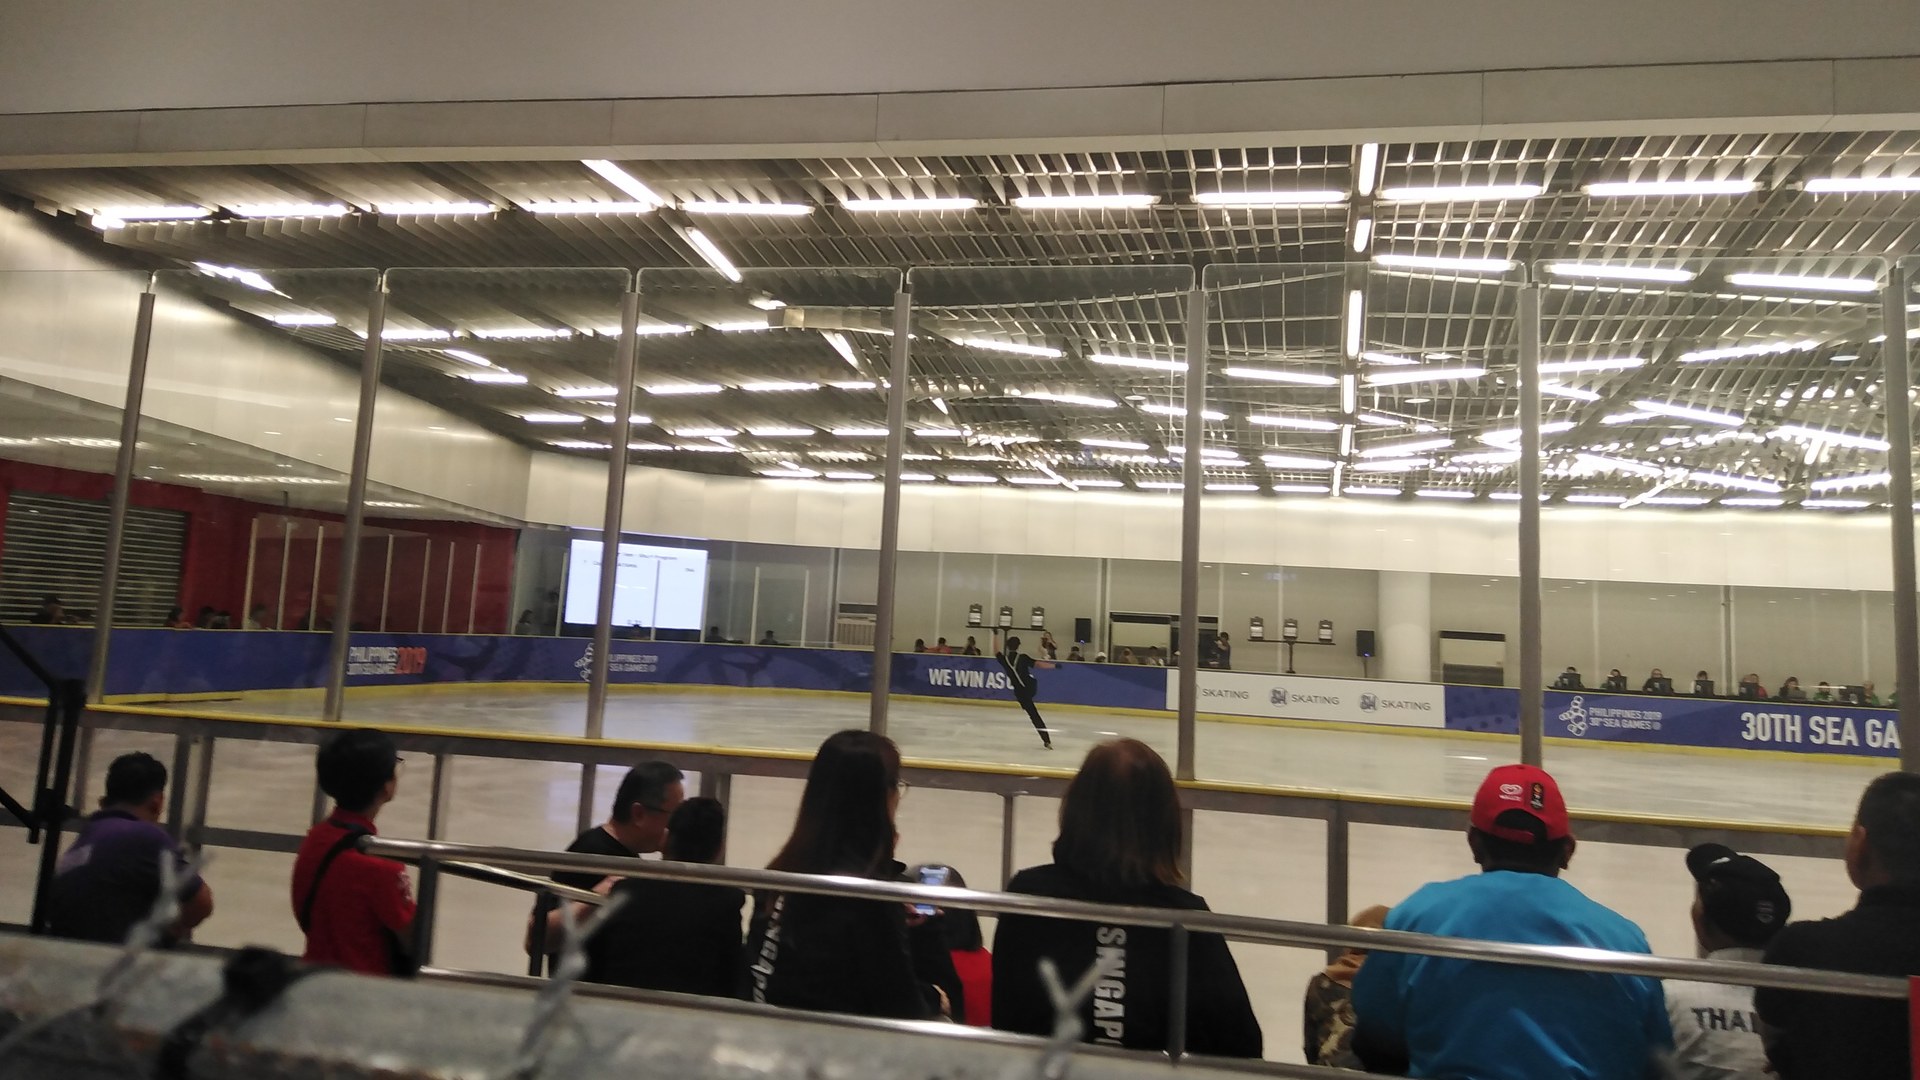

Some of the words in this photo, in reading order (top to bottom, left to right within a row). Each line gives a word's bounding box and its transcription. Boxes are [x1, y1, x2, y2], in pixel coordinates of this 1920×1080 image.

[928, 668, 952, 686] WE
[954, 669, 984, 688] WIN
[985, 671, 1005, 690] AS
[1202, 688, 1249, 700] SKATING
[1291, 694, 1340, 706] SKATING
[1380, 699, 1432, 712] SKATING
[1603, 718, 1621, 728] SEA
[1621, 719, 1652, 731] GAMES
[1741, 711, 1802, 743] 30TH
[1808, 715, 1860, 747] SEA
[1865, 718, 1902, 749] GA
